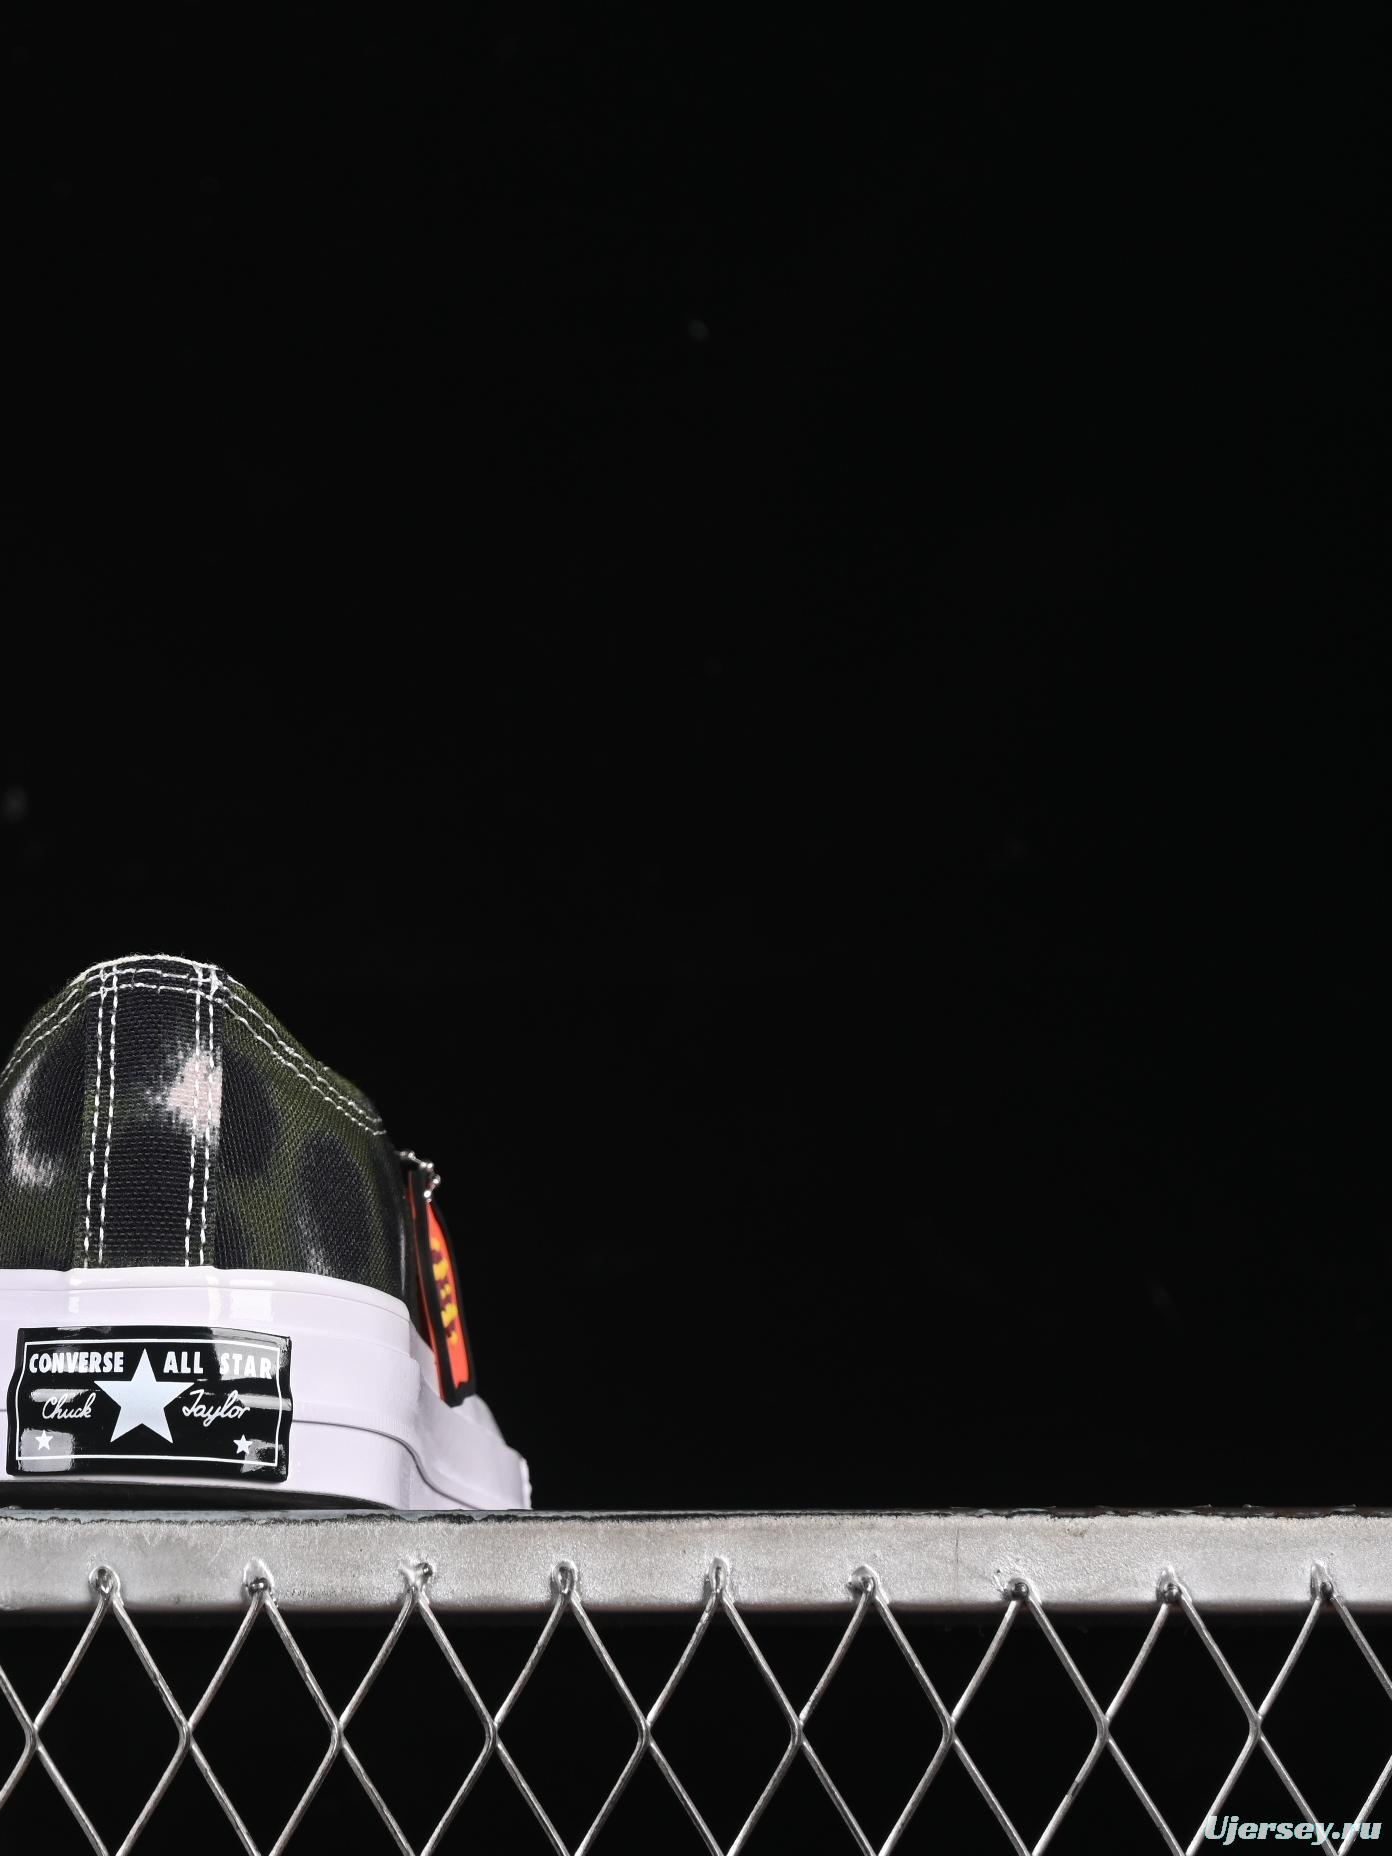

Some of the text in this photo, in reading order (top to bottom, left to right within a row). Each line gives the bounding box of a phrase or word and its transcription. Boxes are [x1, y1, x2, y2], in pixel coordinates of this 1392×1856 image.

[28, 1350, 273, 1380] CONVERSE ALL STAR
[41, 1388, 251, 1428] Chuck Taylor
